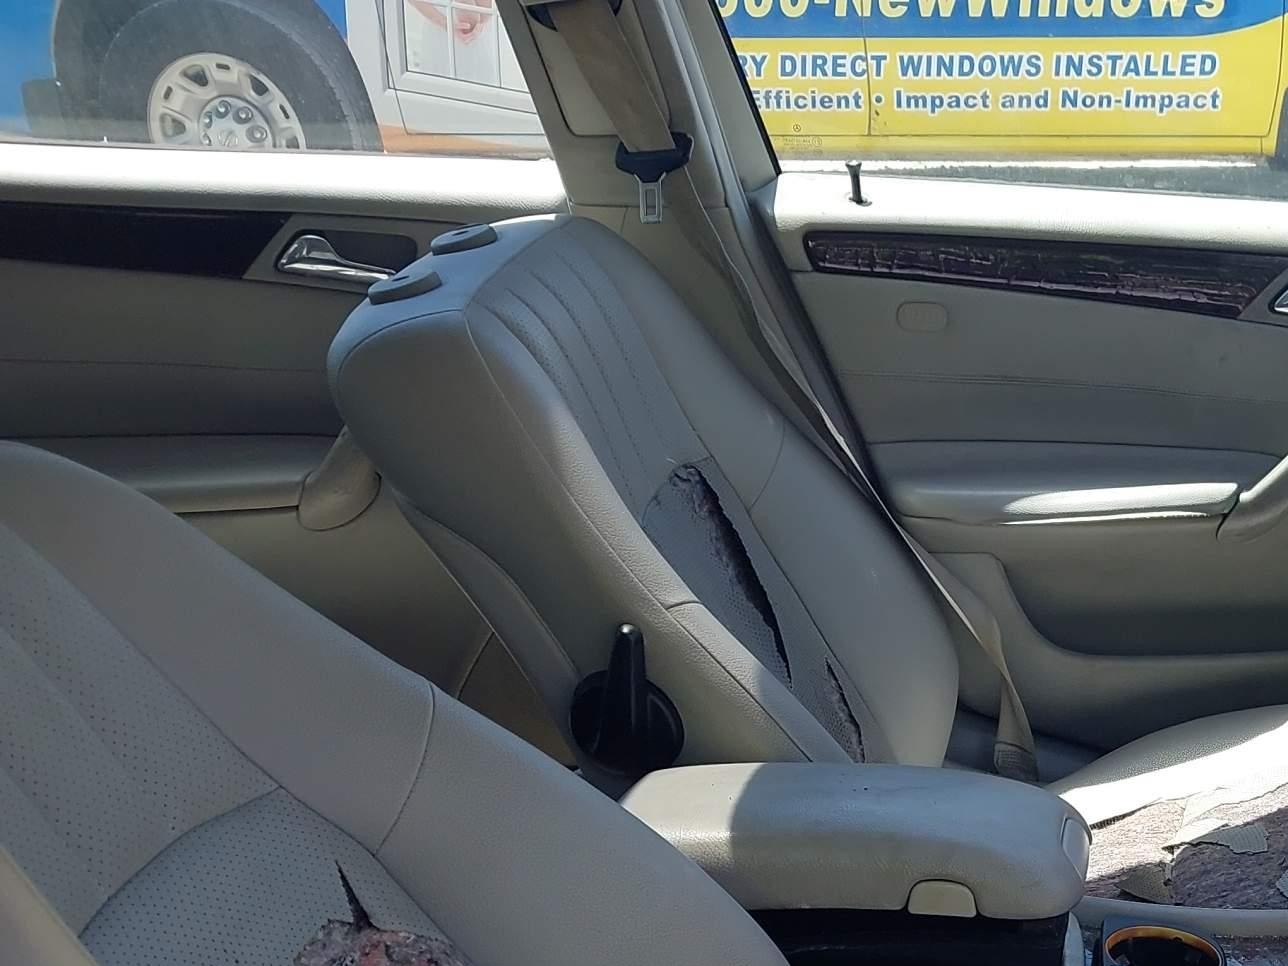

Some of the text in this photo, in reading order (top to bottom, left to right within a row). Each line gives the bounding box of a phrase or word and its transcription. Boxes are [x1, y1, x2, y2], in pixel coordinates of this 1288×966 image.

[779, 54, 888, 78] DIRECT
[899, 54, 1042, 78] WINDOWS
[1053, 54, 1218, 78] INSTALLED
[895, 89, 991, 114] Impact
[1000, 89, 1049, 110] and
[1060, 89, 1220, 114] Non-Impact
